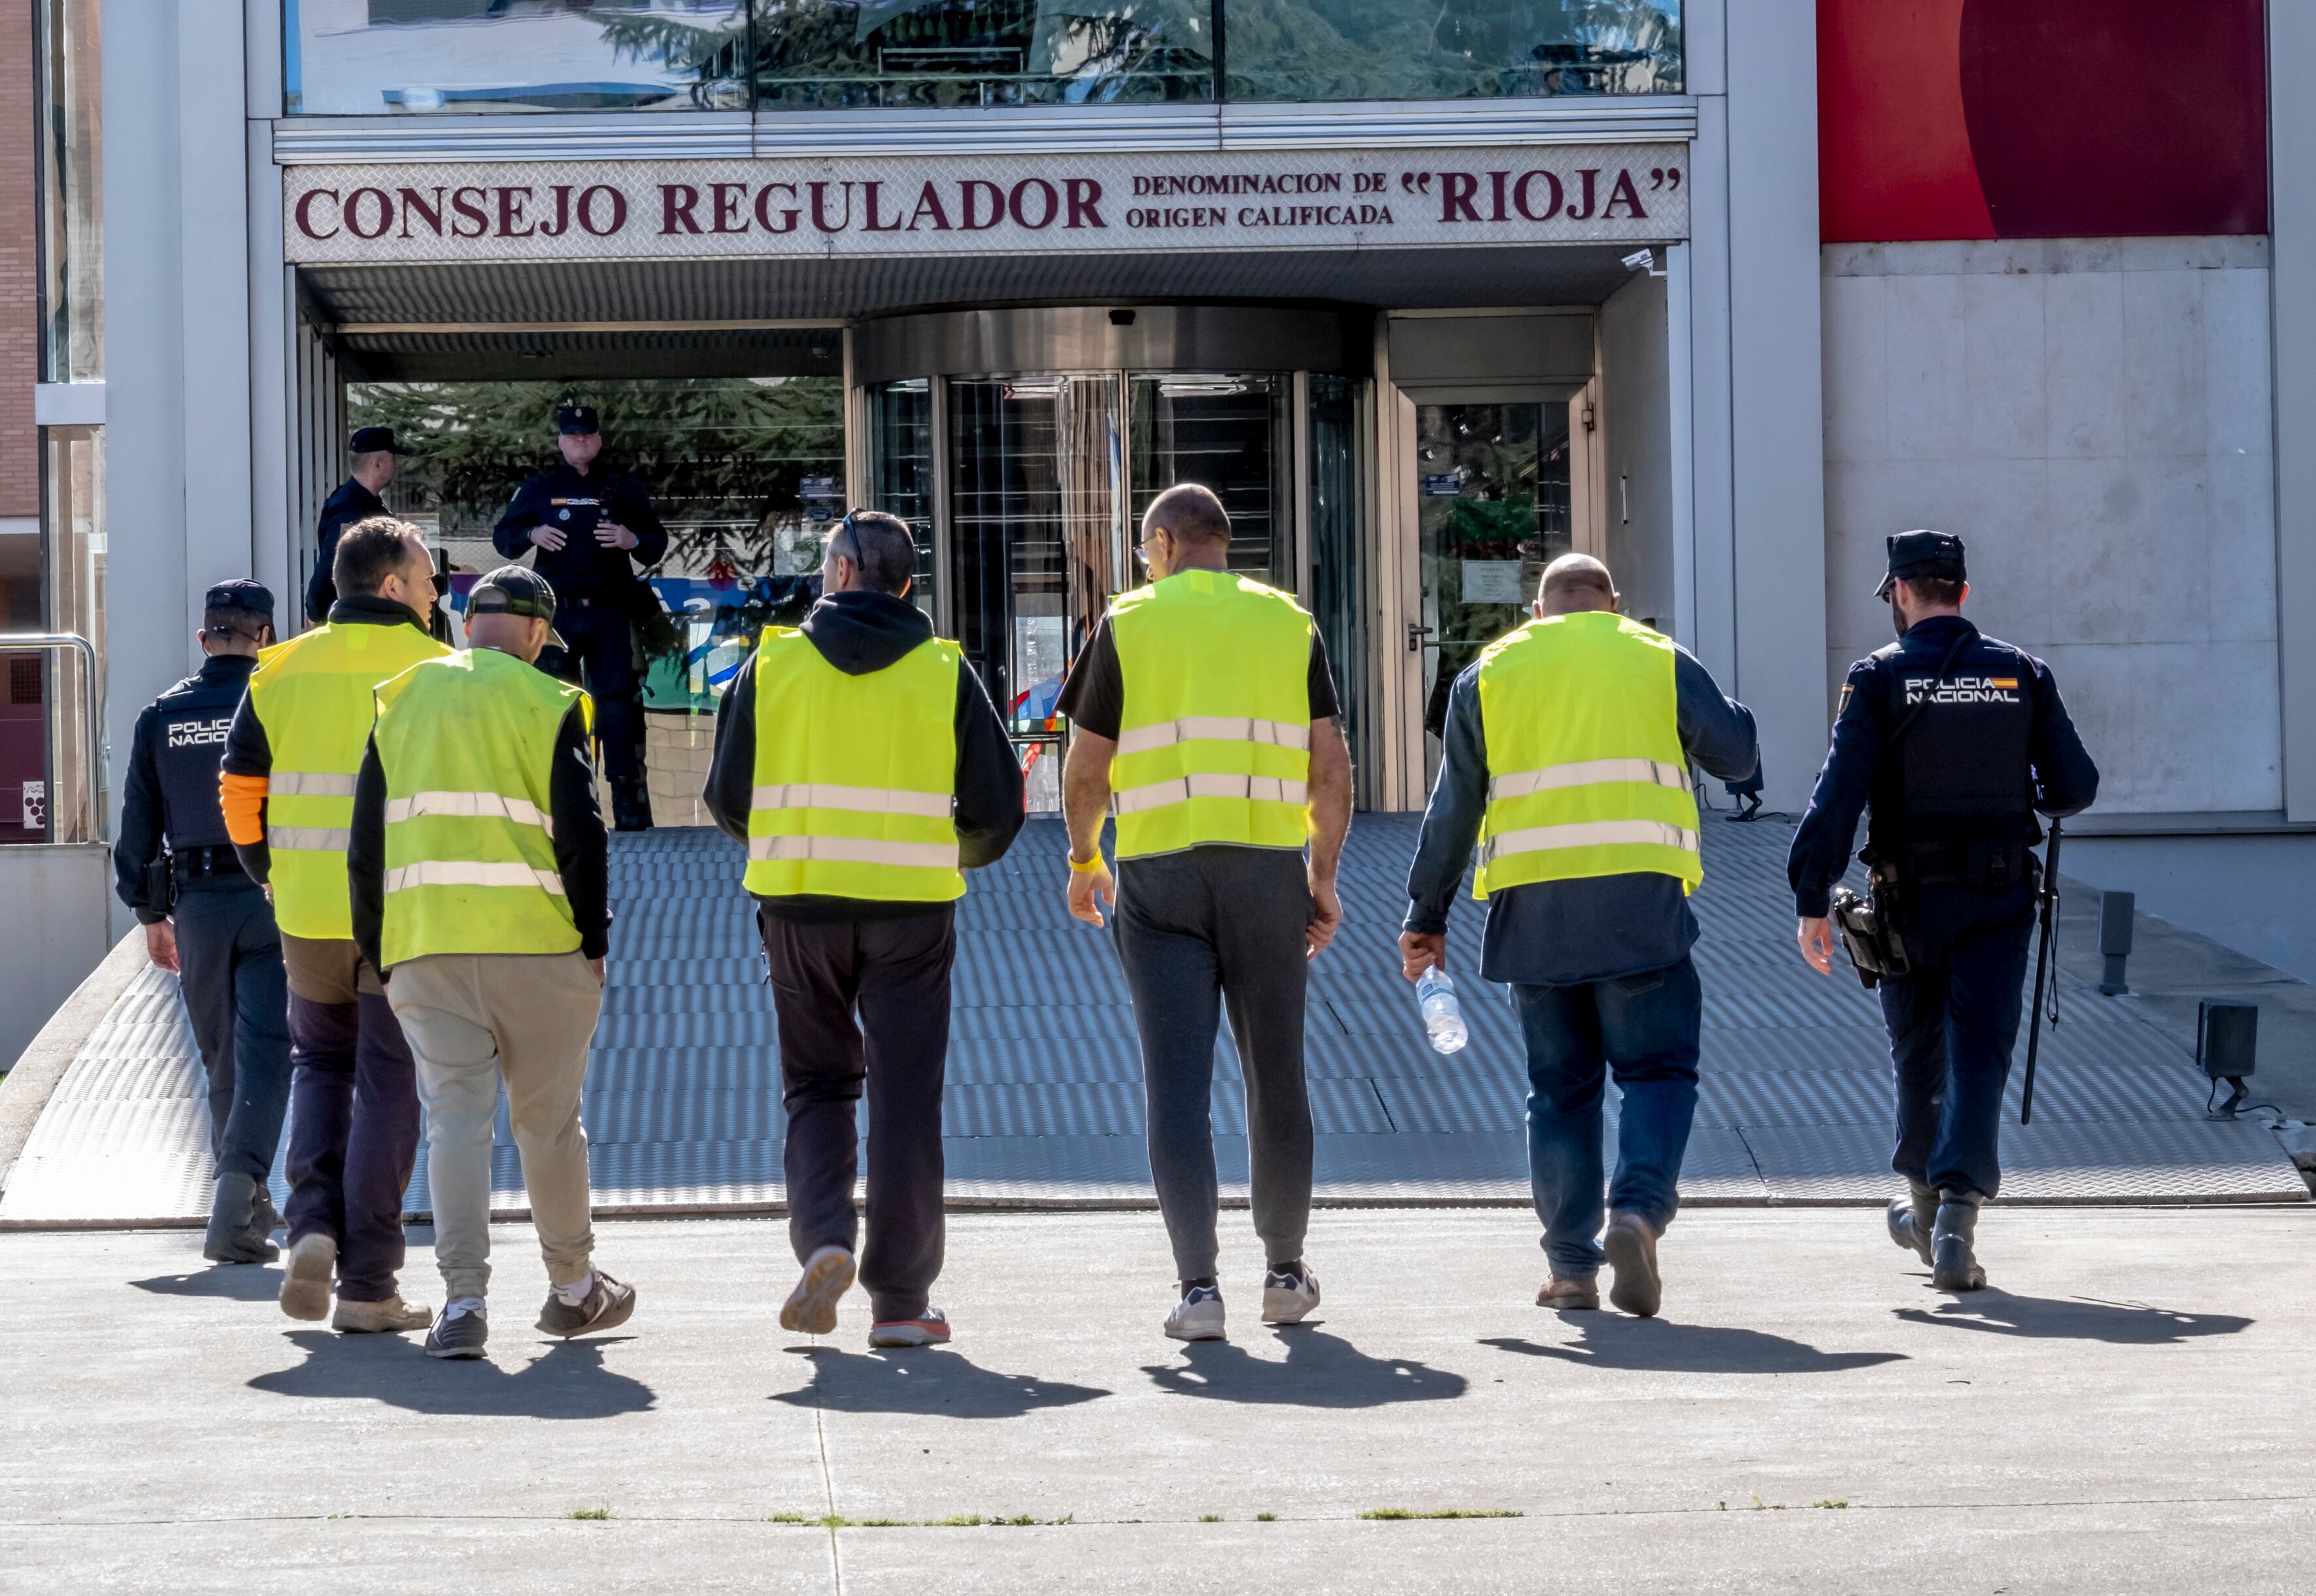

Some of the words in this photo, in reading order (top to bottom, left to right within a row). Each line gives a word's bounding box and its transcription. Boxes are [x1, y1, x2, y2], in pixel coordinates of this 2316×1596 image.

[1132, 173, 1343, 195] DENOMINACION
[1352, 173, 1387, 193] DE
[295, 185, 628, 240] CONSEJO
[656, 178, 1109, 235] REGULADOR
[1126, 207, 1227, 228] ORIGEN
[1237, 205, 1394, 227] CALIFICADA
[169, 731, 228, 748] NACIO
